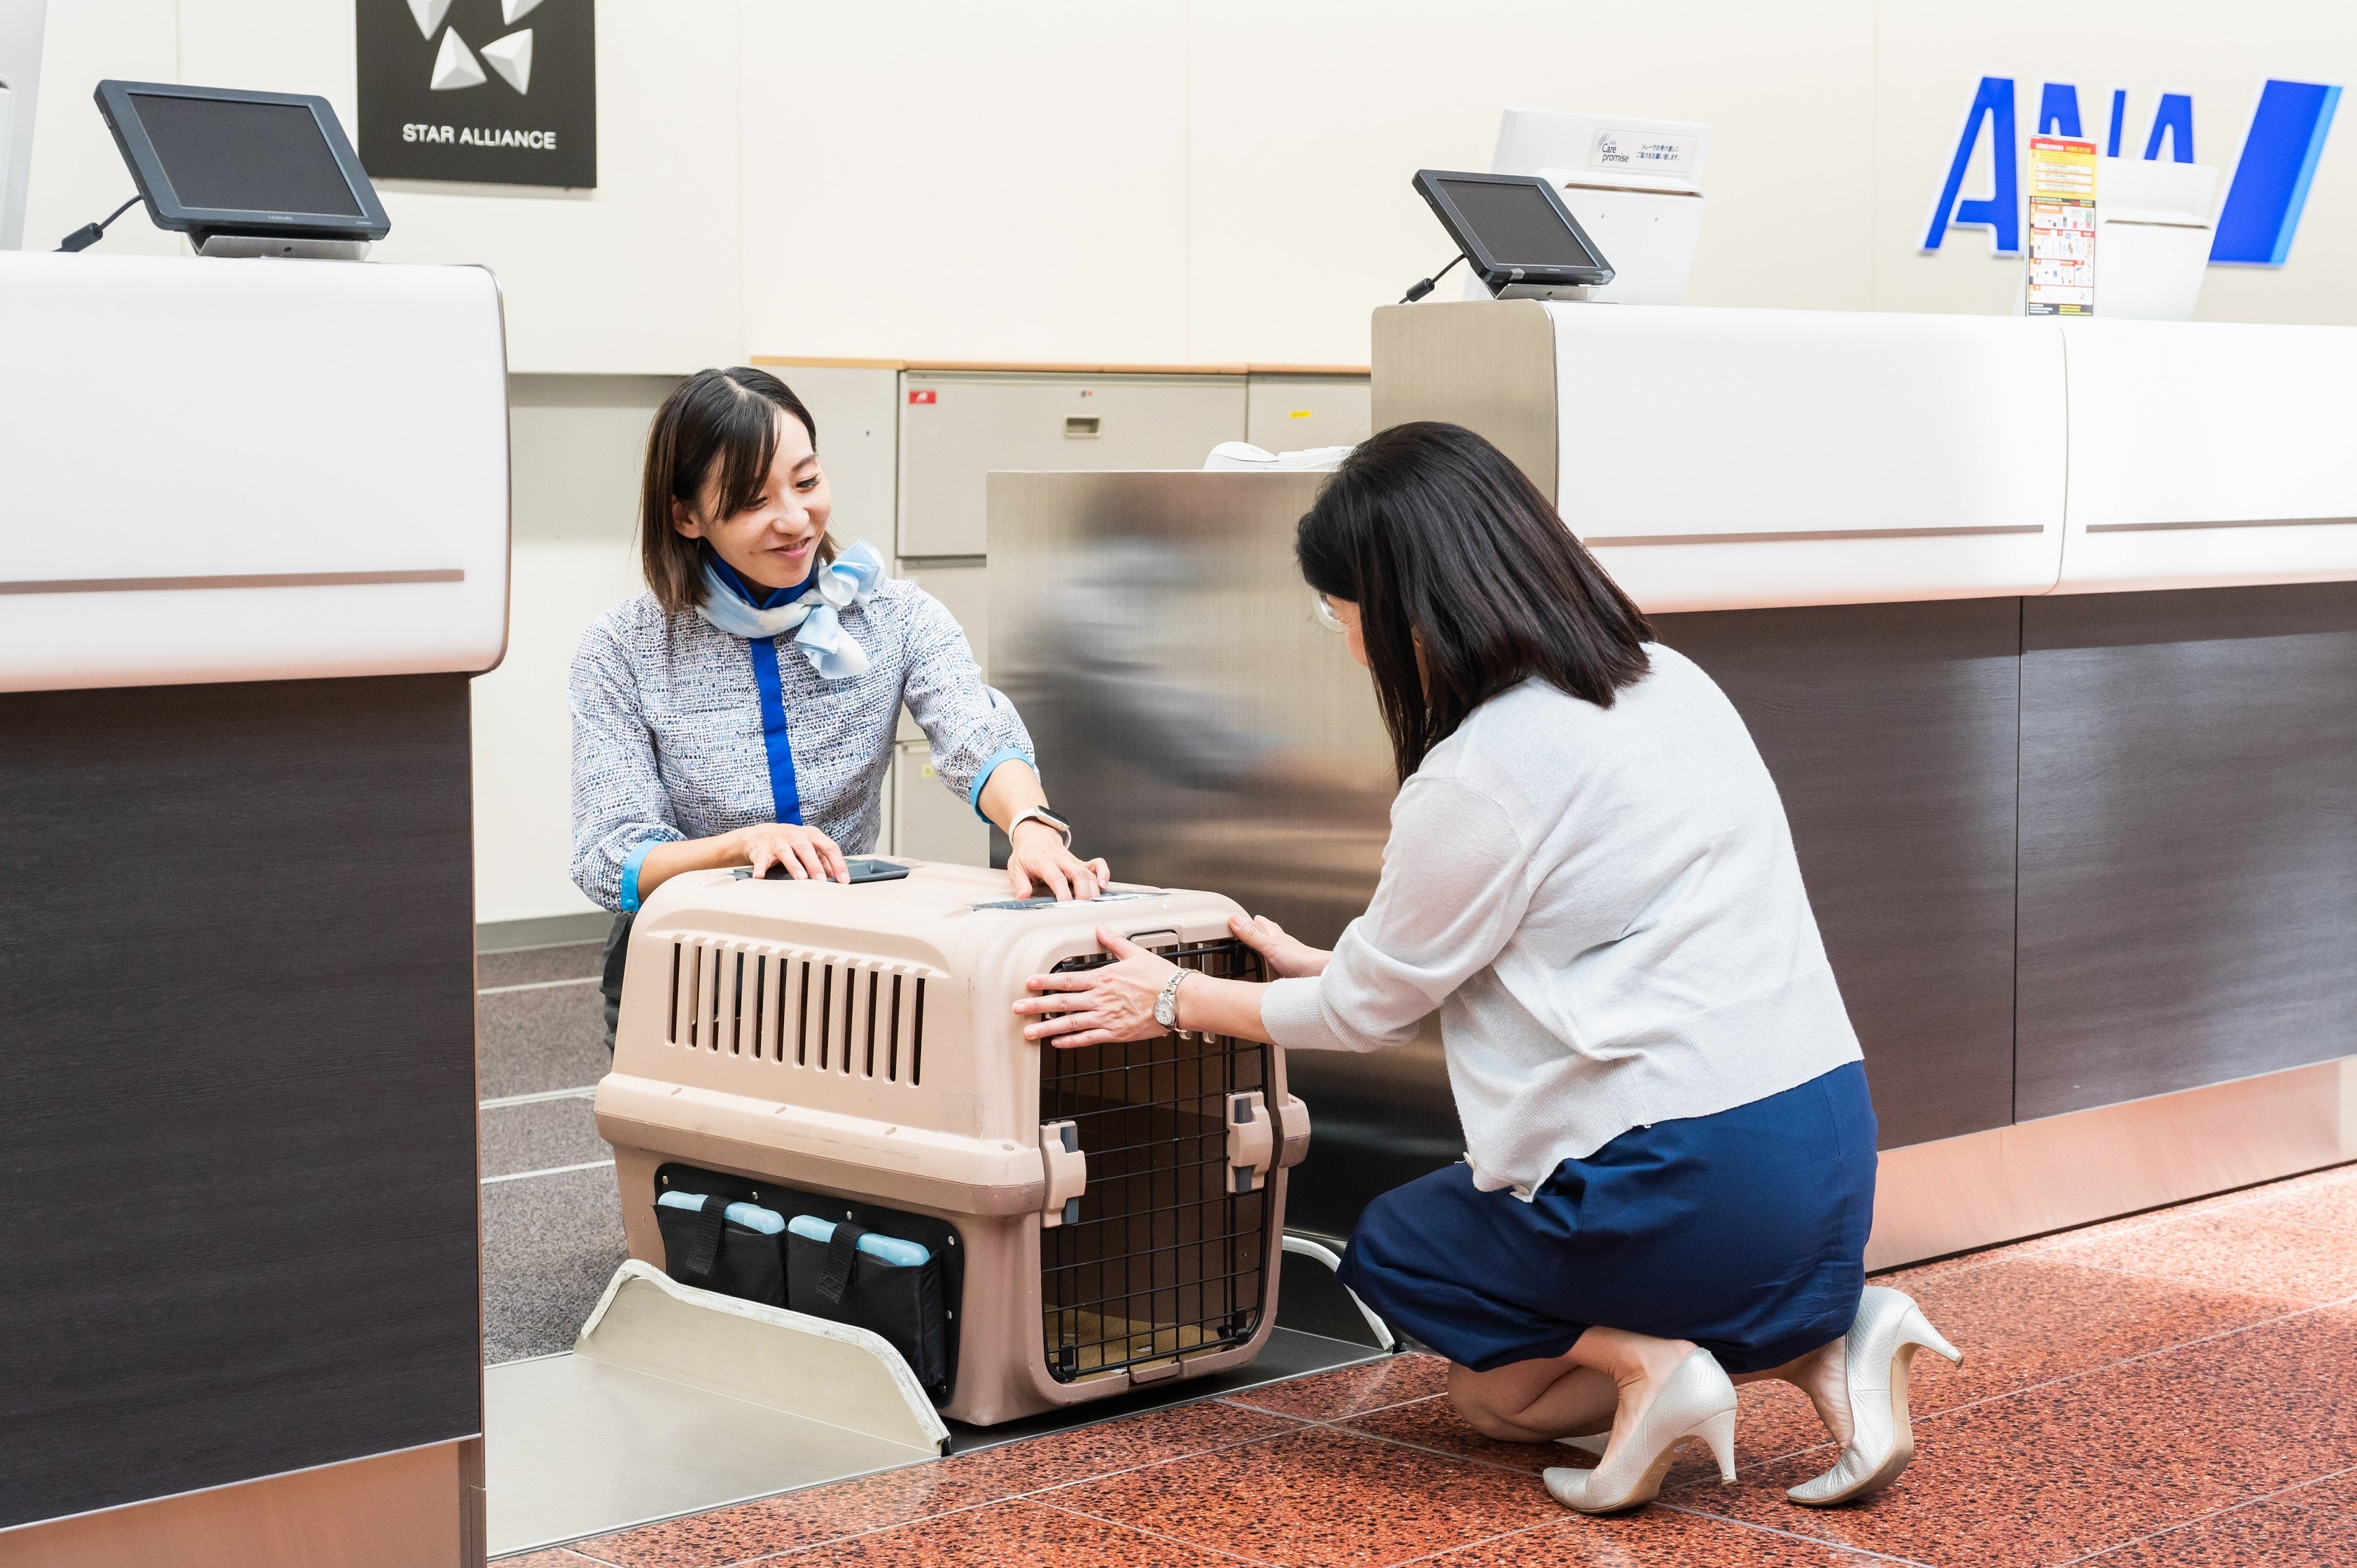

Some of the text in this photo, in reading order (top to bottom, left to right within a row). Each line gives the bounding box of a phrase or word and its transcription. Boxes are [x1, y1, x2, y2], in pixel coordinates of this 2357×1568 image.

[403, 123, 557, 150] STAR ALLIANCE
[1602, 143, 1617, 153] Care
[1602, 153, 1630, 163] promise
